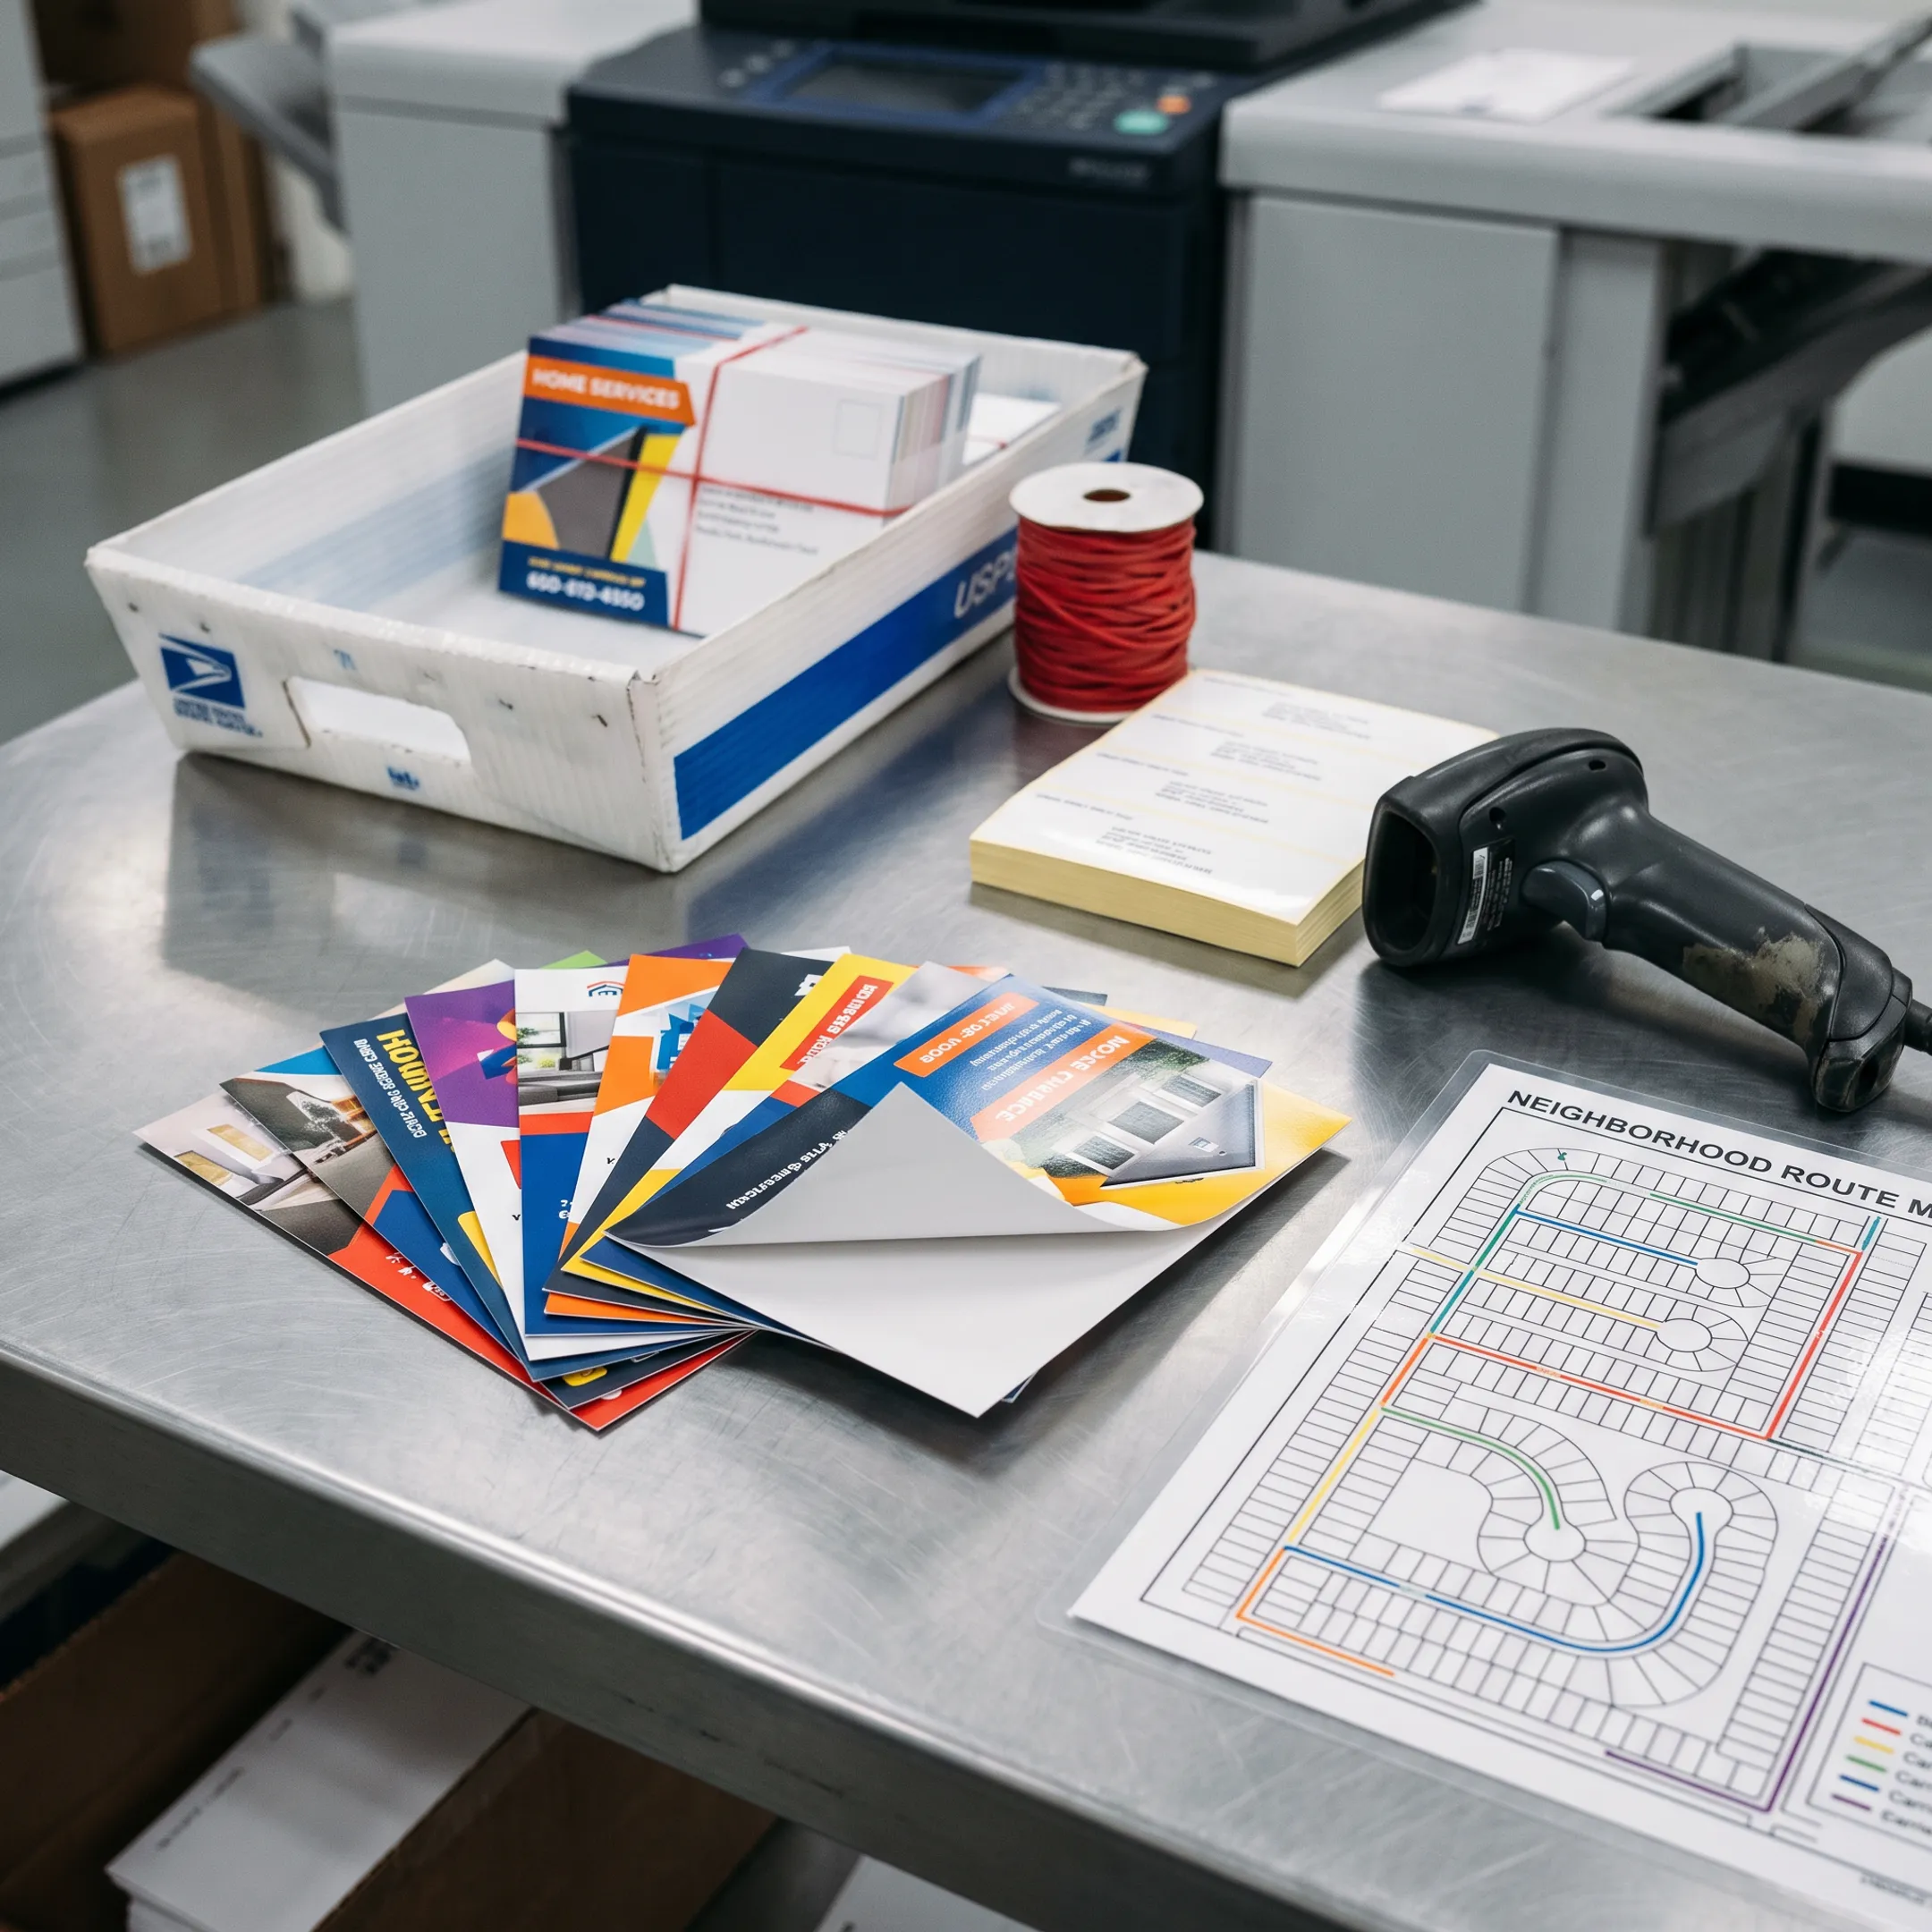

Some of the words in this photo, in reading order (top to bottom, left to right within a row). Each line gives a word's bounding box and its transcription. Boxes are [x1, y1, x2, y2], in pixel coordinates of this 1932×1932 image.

[532, 368, 587, 394] HOME
[589, 377, 681, 410] SERVICES
[953, 547, 1016, 619] USP
[1507, 1090, 1772, 1173] NEIGHBORHOOD
[1781, 1165, 1900, 1208] ROUTE
